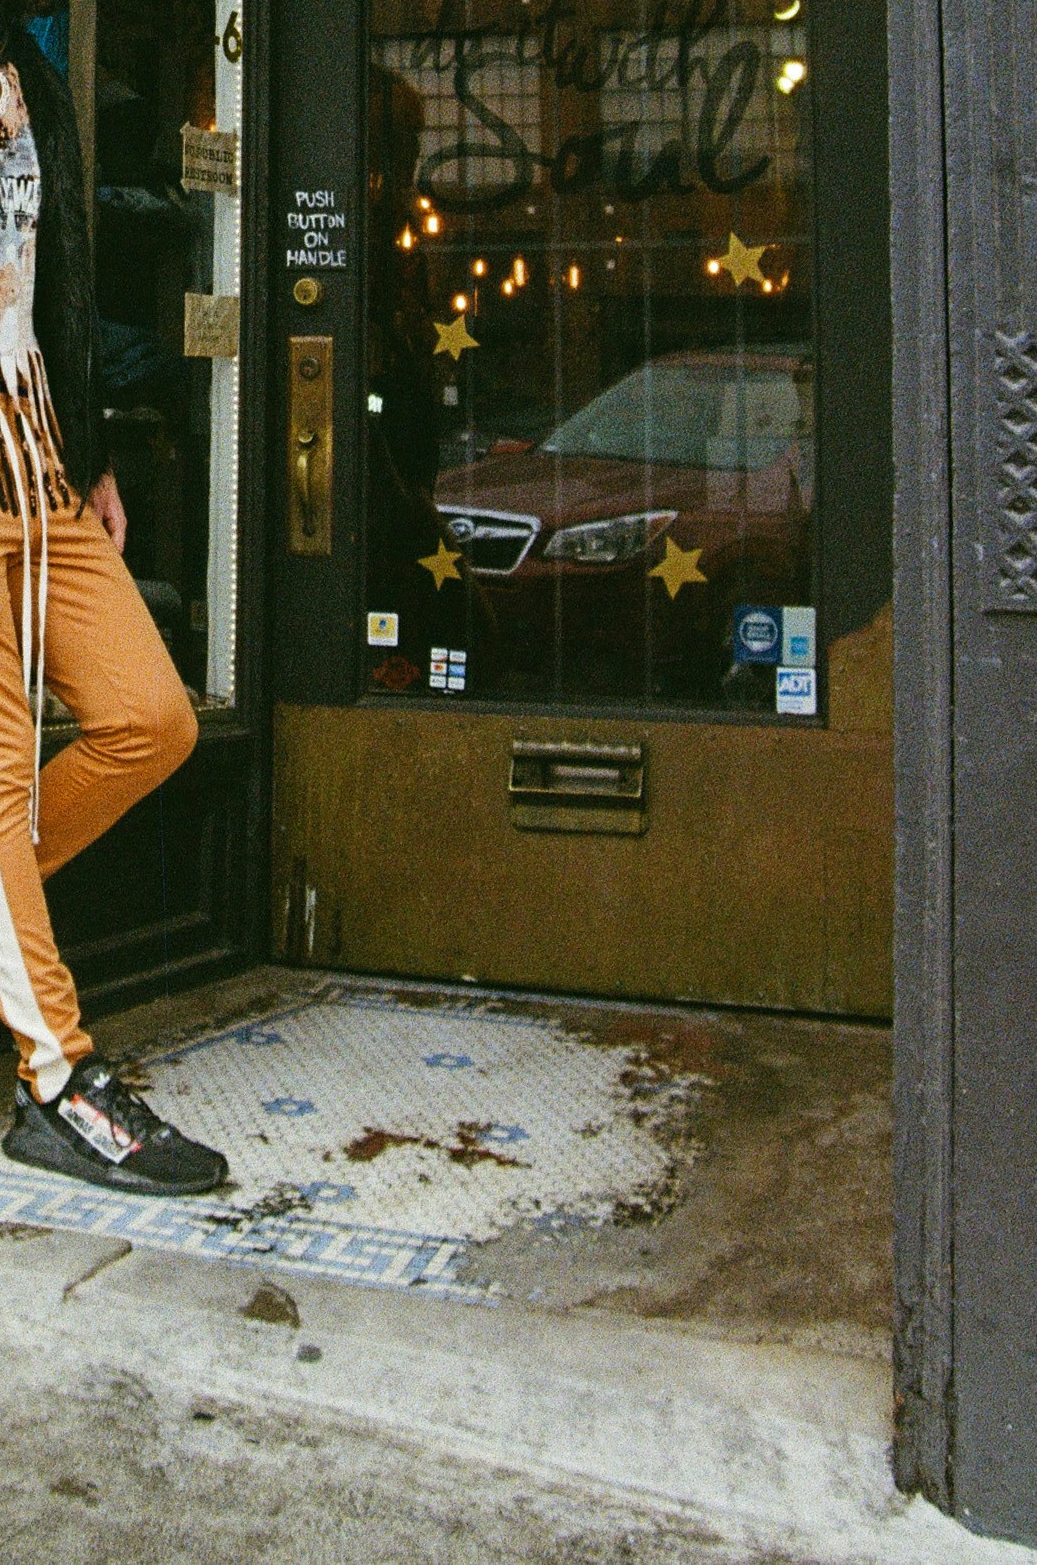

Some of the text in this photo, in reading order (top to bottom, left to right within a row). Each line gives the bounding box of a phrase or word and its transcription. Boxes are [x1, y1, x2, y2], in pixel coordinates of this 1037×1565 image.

[417, 39, 772, 213] Soul
[295, 190, 335, 208] PUSH
[287, 212, 346, 230] BUTTON
[304, 231, 329, 248] ON
[285, 249, 347, 267] HANDLE
